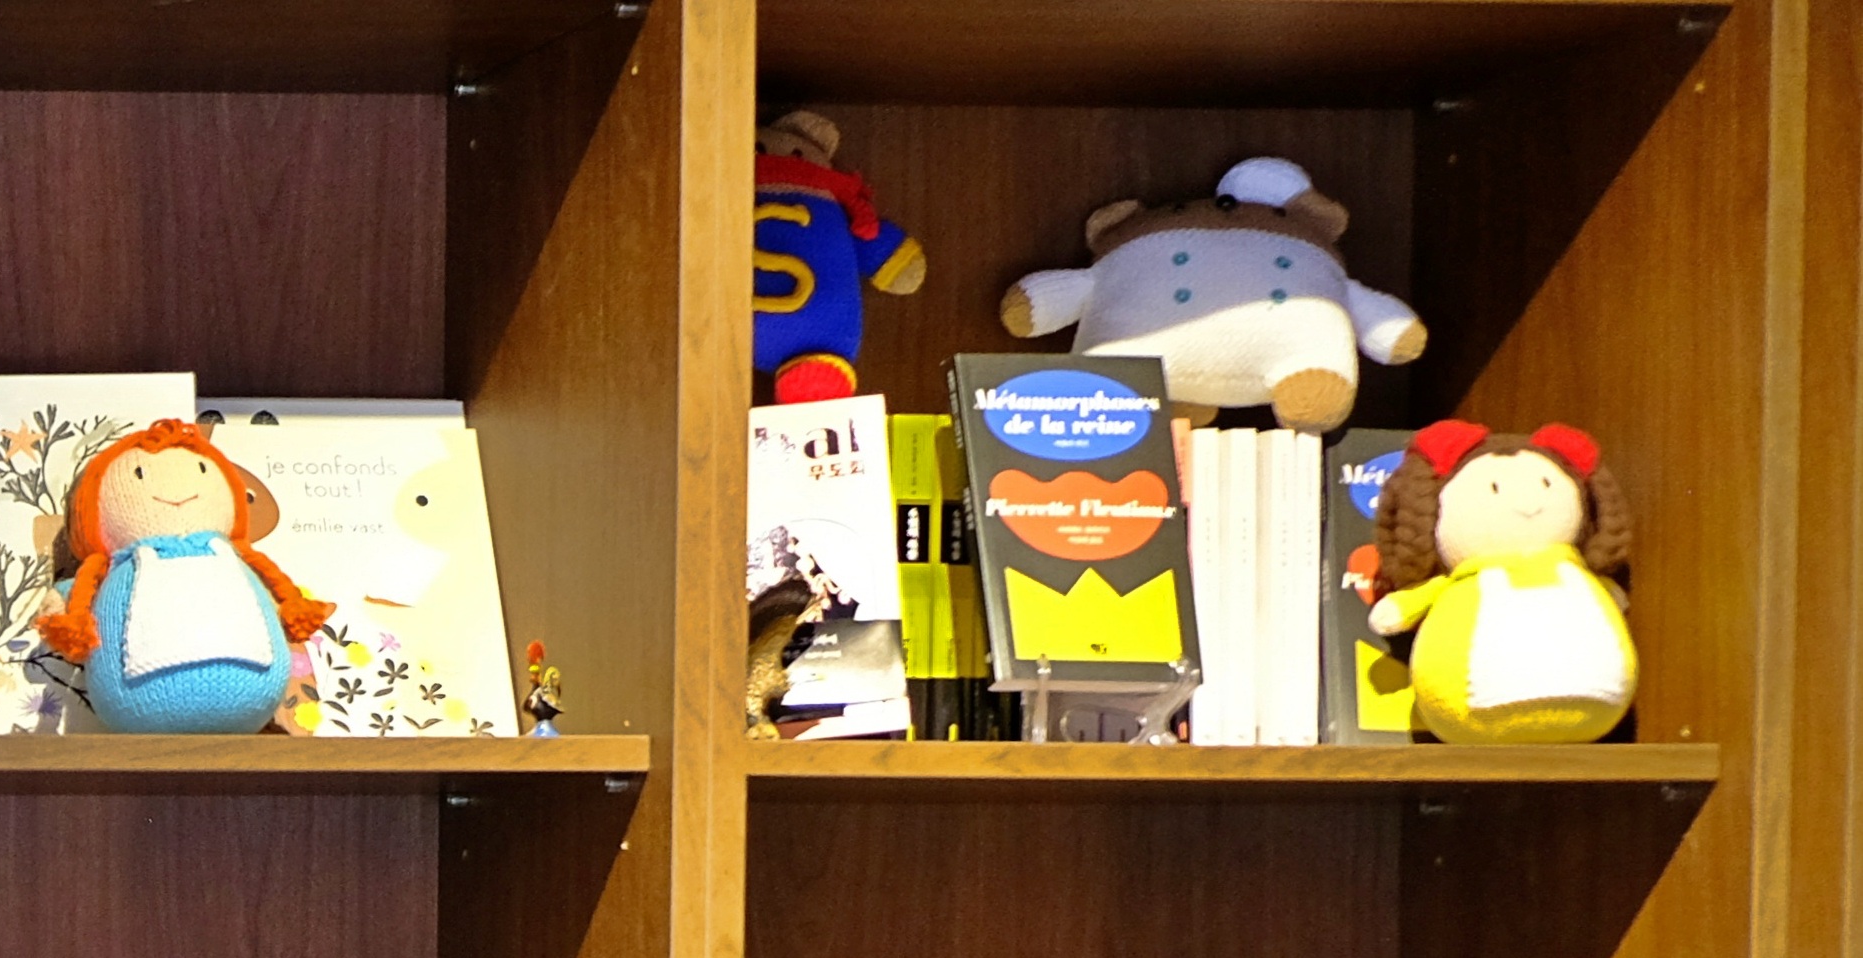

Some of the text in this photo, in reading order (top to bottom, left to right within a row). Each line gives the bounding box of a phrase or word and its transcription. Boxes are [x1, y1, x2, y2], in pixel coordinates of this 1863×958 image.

[974, 387, 1161, 418] Métamorphoses
[1003, 413, 1137, 435] de la reine
[265, 454, 397, 479] je confonds
